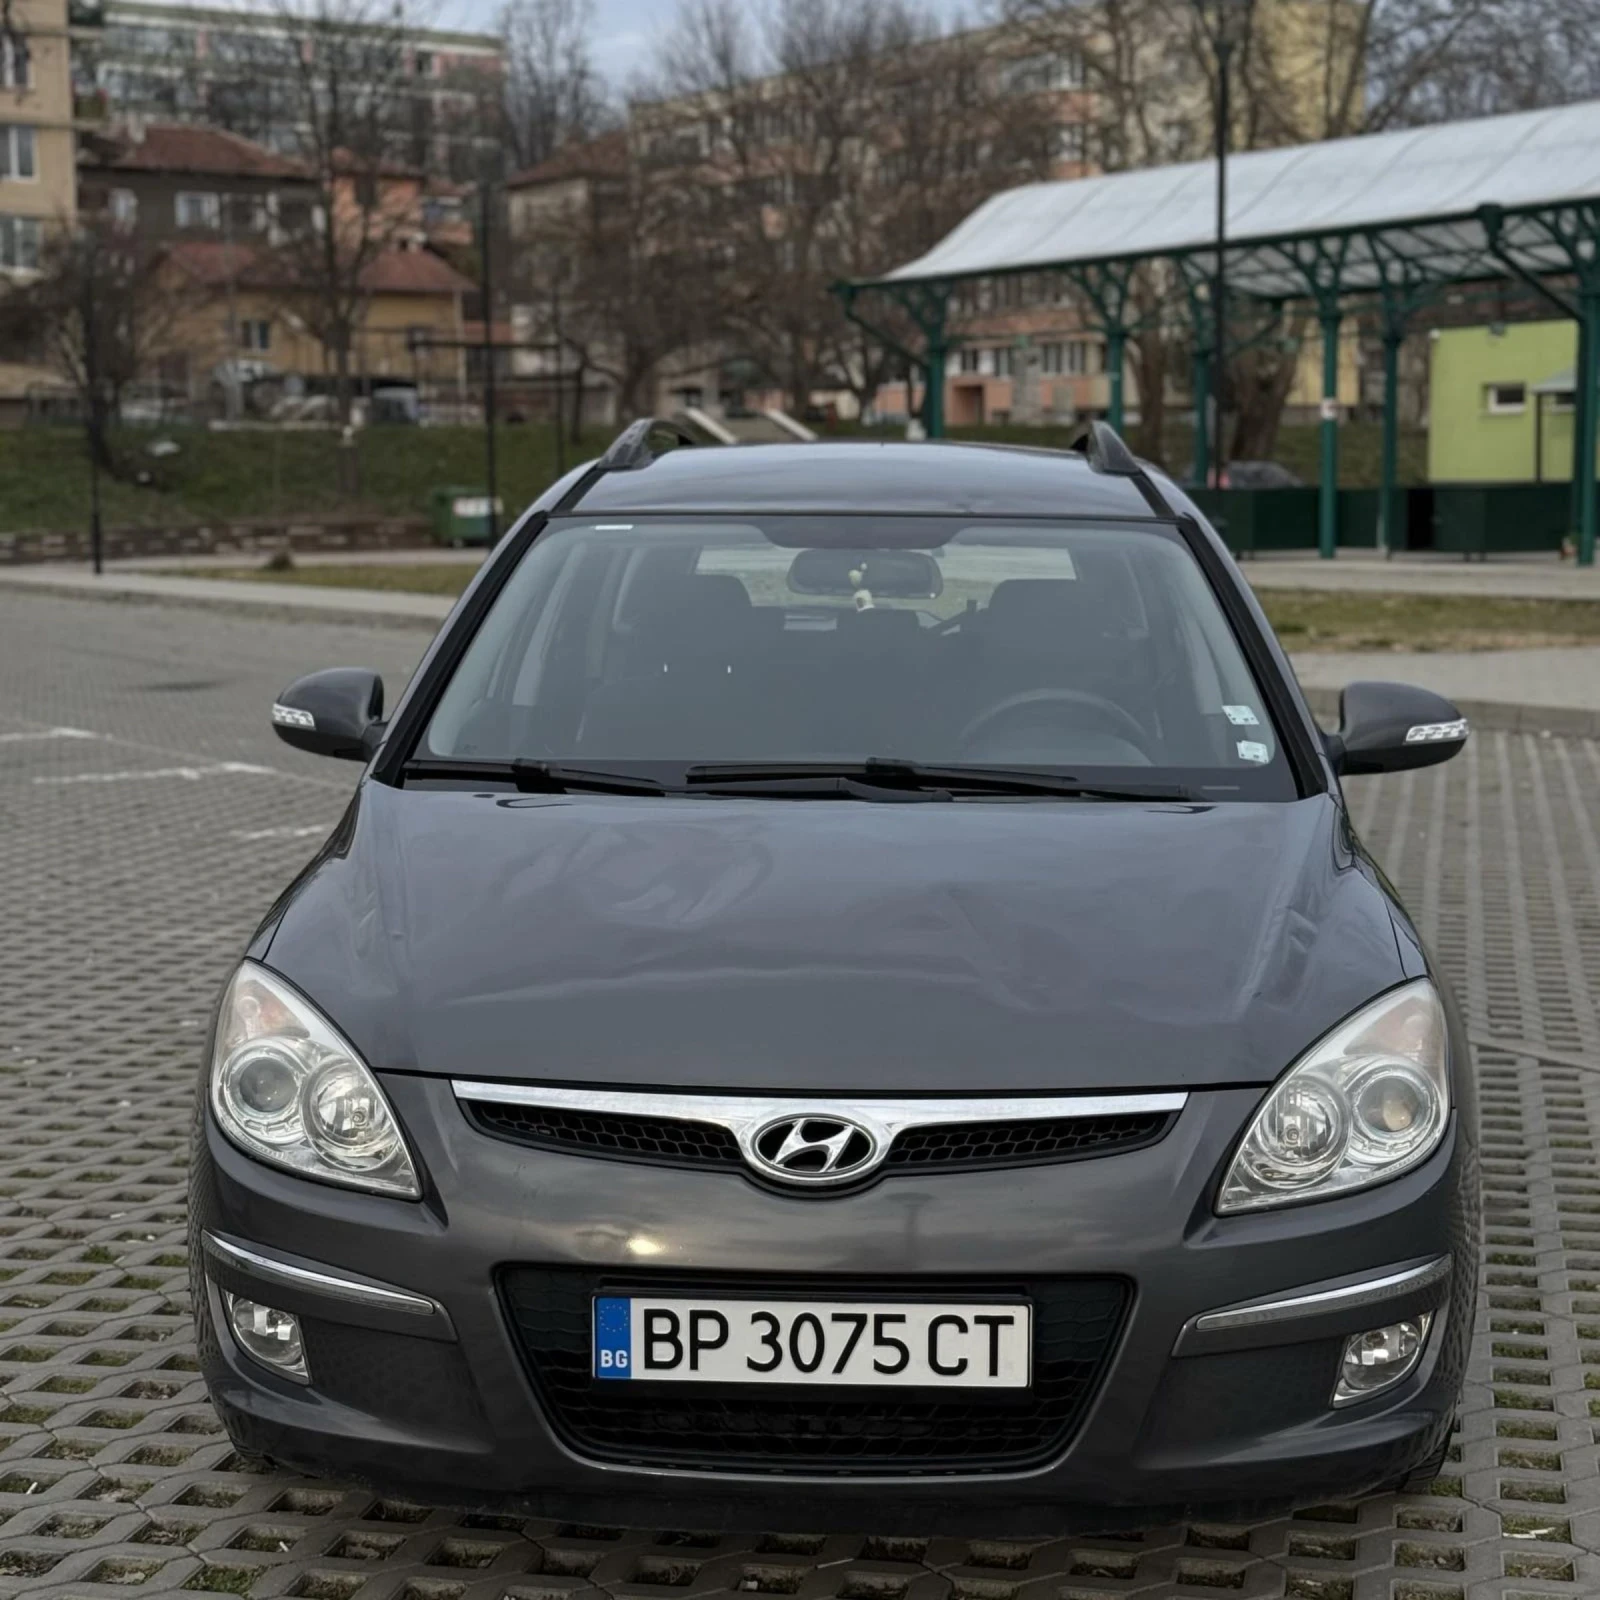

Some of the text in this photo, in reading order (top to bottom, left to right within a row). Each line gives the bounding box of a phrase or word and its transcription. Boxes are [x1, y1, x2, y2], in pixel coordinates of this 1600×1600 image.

[600, 1349, 628, 1368] BG
[643, 1308, 1015, 1377] BP 3075 CT
